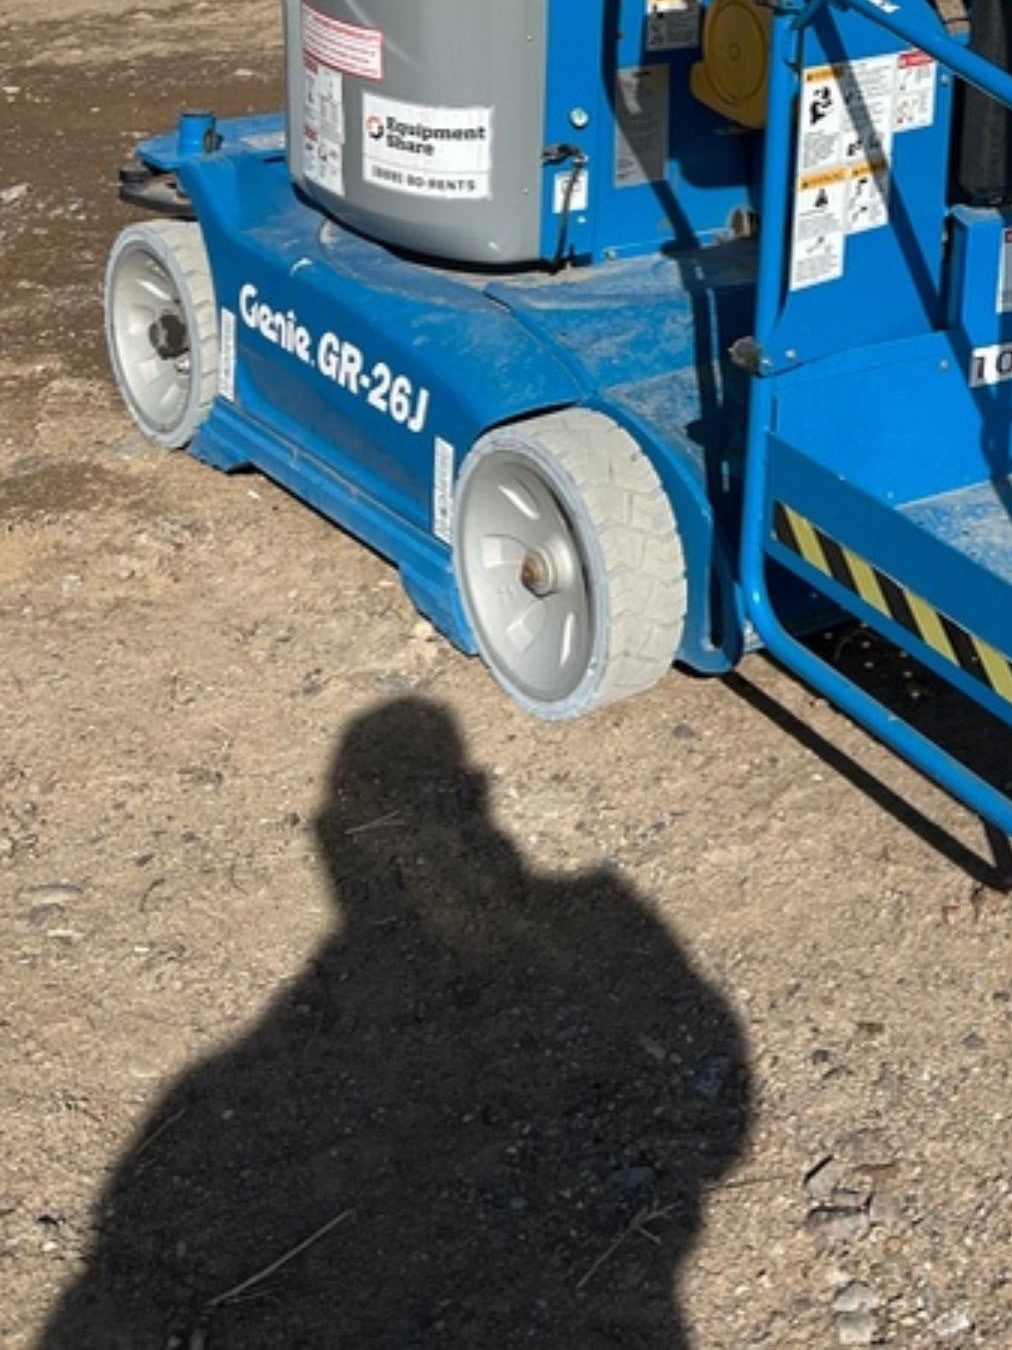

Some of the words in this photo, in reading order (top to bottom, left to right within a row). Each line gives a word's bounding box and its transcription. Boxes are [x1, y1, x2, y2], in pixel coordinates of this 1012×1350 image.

[386, 116, 486, 142] Equipment
[386, 134, 435, 156] Share
[239, 283, 312, 364] Genie
[317, 331, 430, 433] GR-26J
